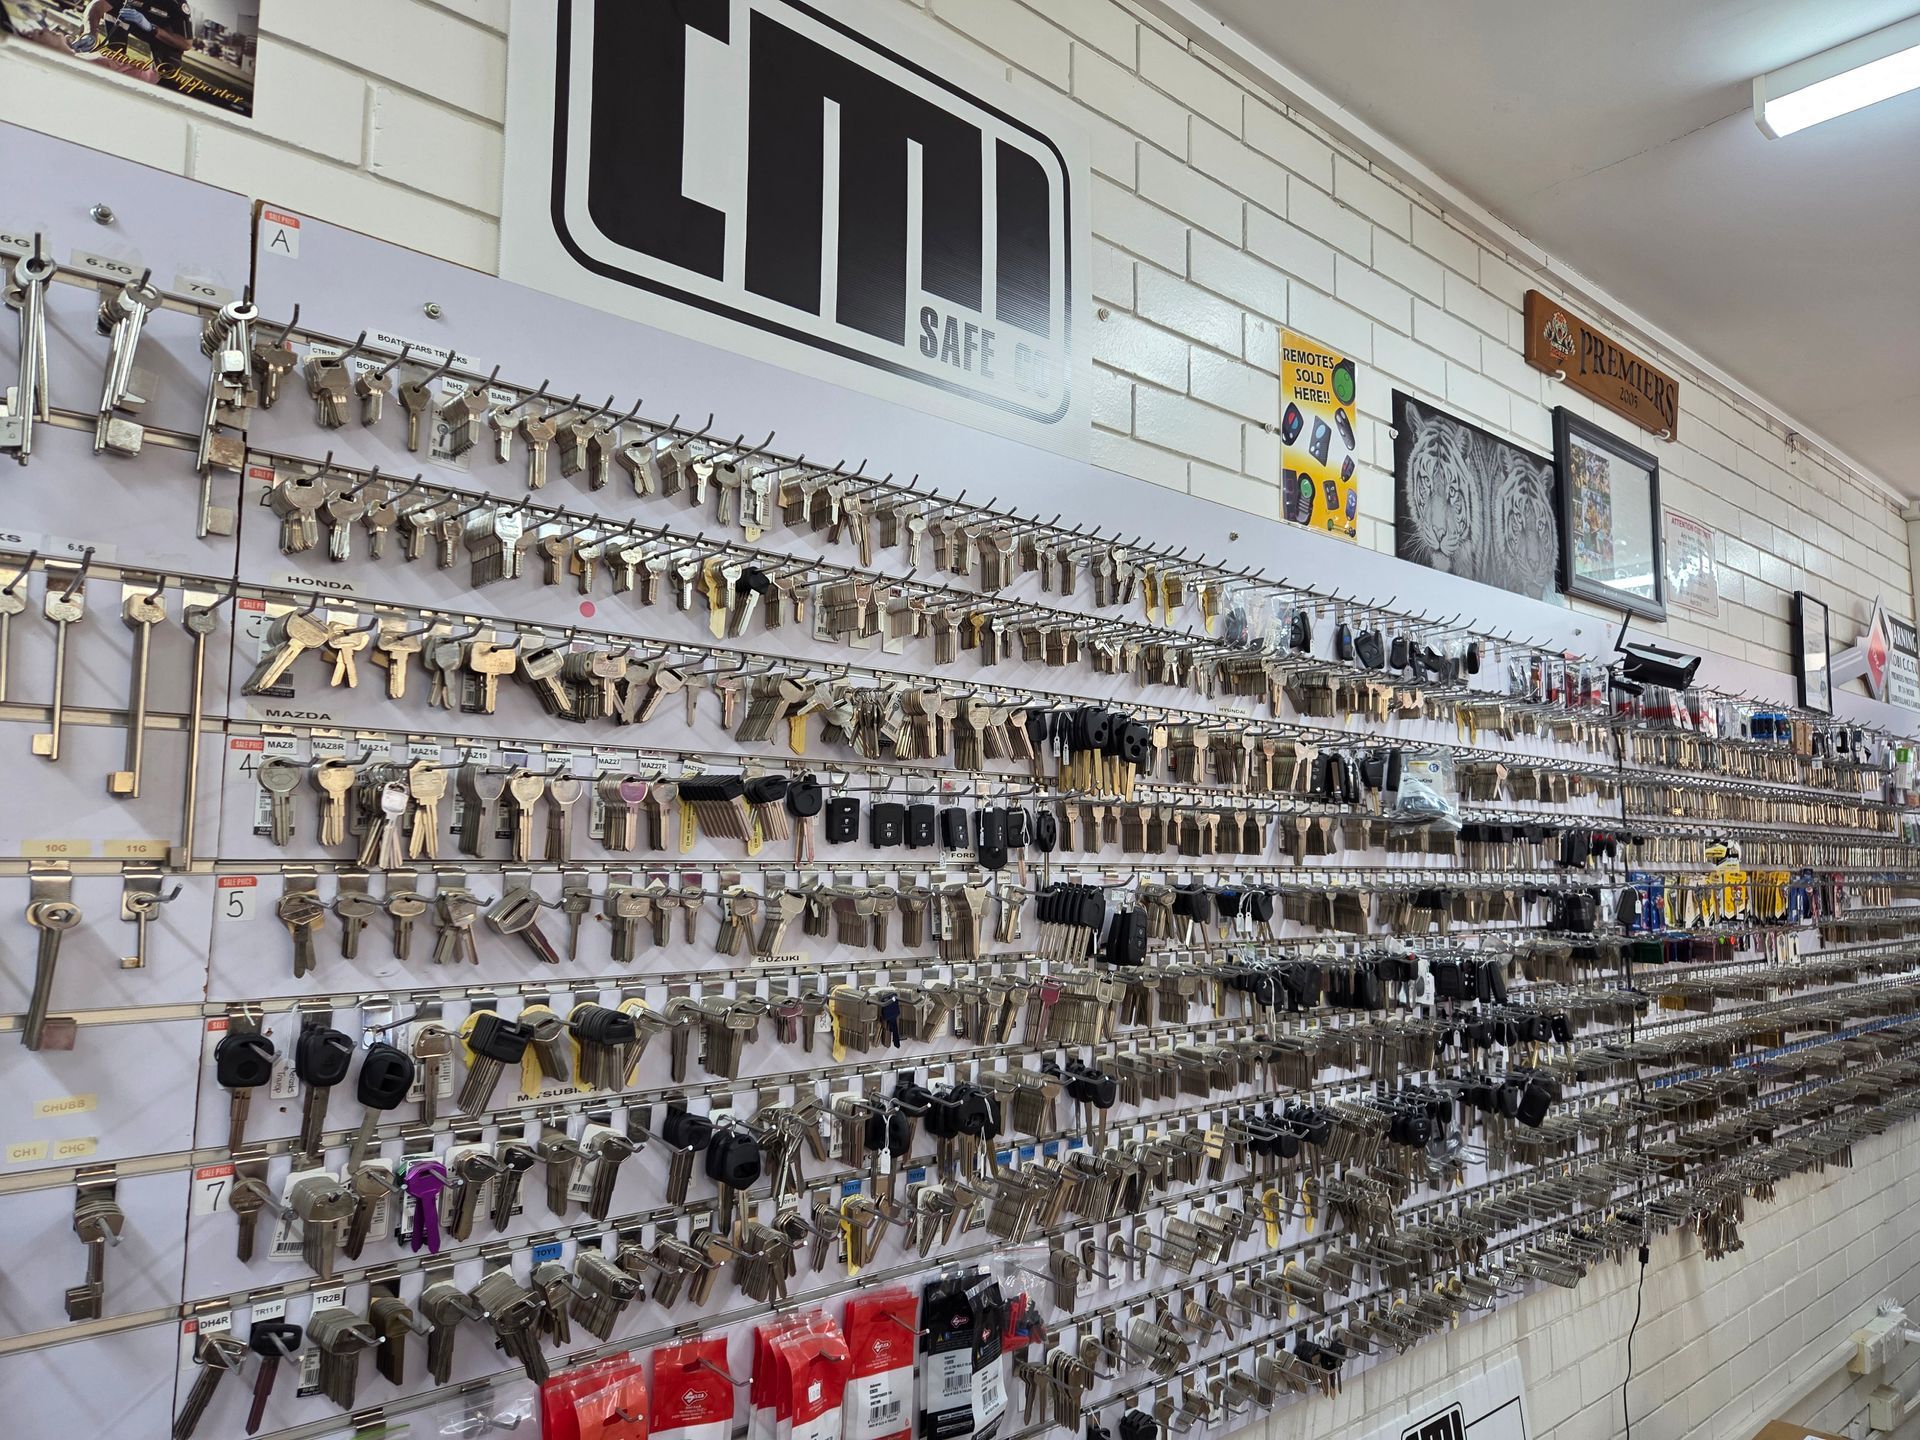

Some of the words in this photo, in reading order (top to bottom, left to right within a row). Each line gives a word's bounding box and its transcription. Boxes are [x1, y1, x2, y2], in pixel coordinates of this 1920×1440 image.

[156, 63, 244, 104] Supporter
[271, 229, 290, 253] A
[86, 257, 133, 275] 6.5G
[190, 283, 216, 297] 7G
[919, 305, 995, 380] SAFE
[409, 343, 432, 355] CARS
[434, 349, 468, 365] TRUCKS
[1283, 348, 1334, 369] REMOTES
[1296, 369, 1324, 385] SOLD
[1579, 327, 1674, 428] PREMIERS
[1294, 386, 1331, 404] HERE!!
[1620, 387, 1638, 408] 2005
[288, 576, 354, 591] HONDA
[266, 709, 332, 720] MAZDA
[267, 741, 293, 749] MAZ8
[313, 741, 344, 751] MAZ8R
[360, 743, 389, 753] MAZ14
[411, 747, 438, 756] MAZ16
[239, 754, 257, 779] 4
[599, 757, 621, 765] MAZ27
[641, 763, 667, 771] MAZ27R
[45, 843, 67, 853] 10G
[126, 844, 147, 853] 11G
[226, 890, 244, 918] 5
[757, 955, 799, 964] SUZUKI
[42, 1098, 86, 1113] CHUBB
[59, 1142, 86, 1154] CHC
[207, 1180, 225, 1211] 7
[316, 1294, 341, 1304] TR2B
[255, 1307, 275, 1316] TR11
[200, 1317, 229, 1330] DH4R
